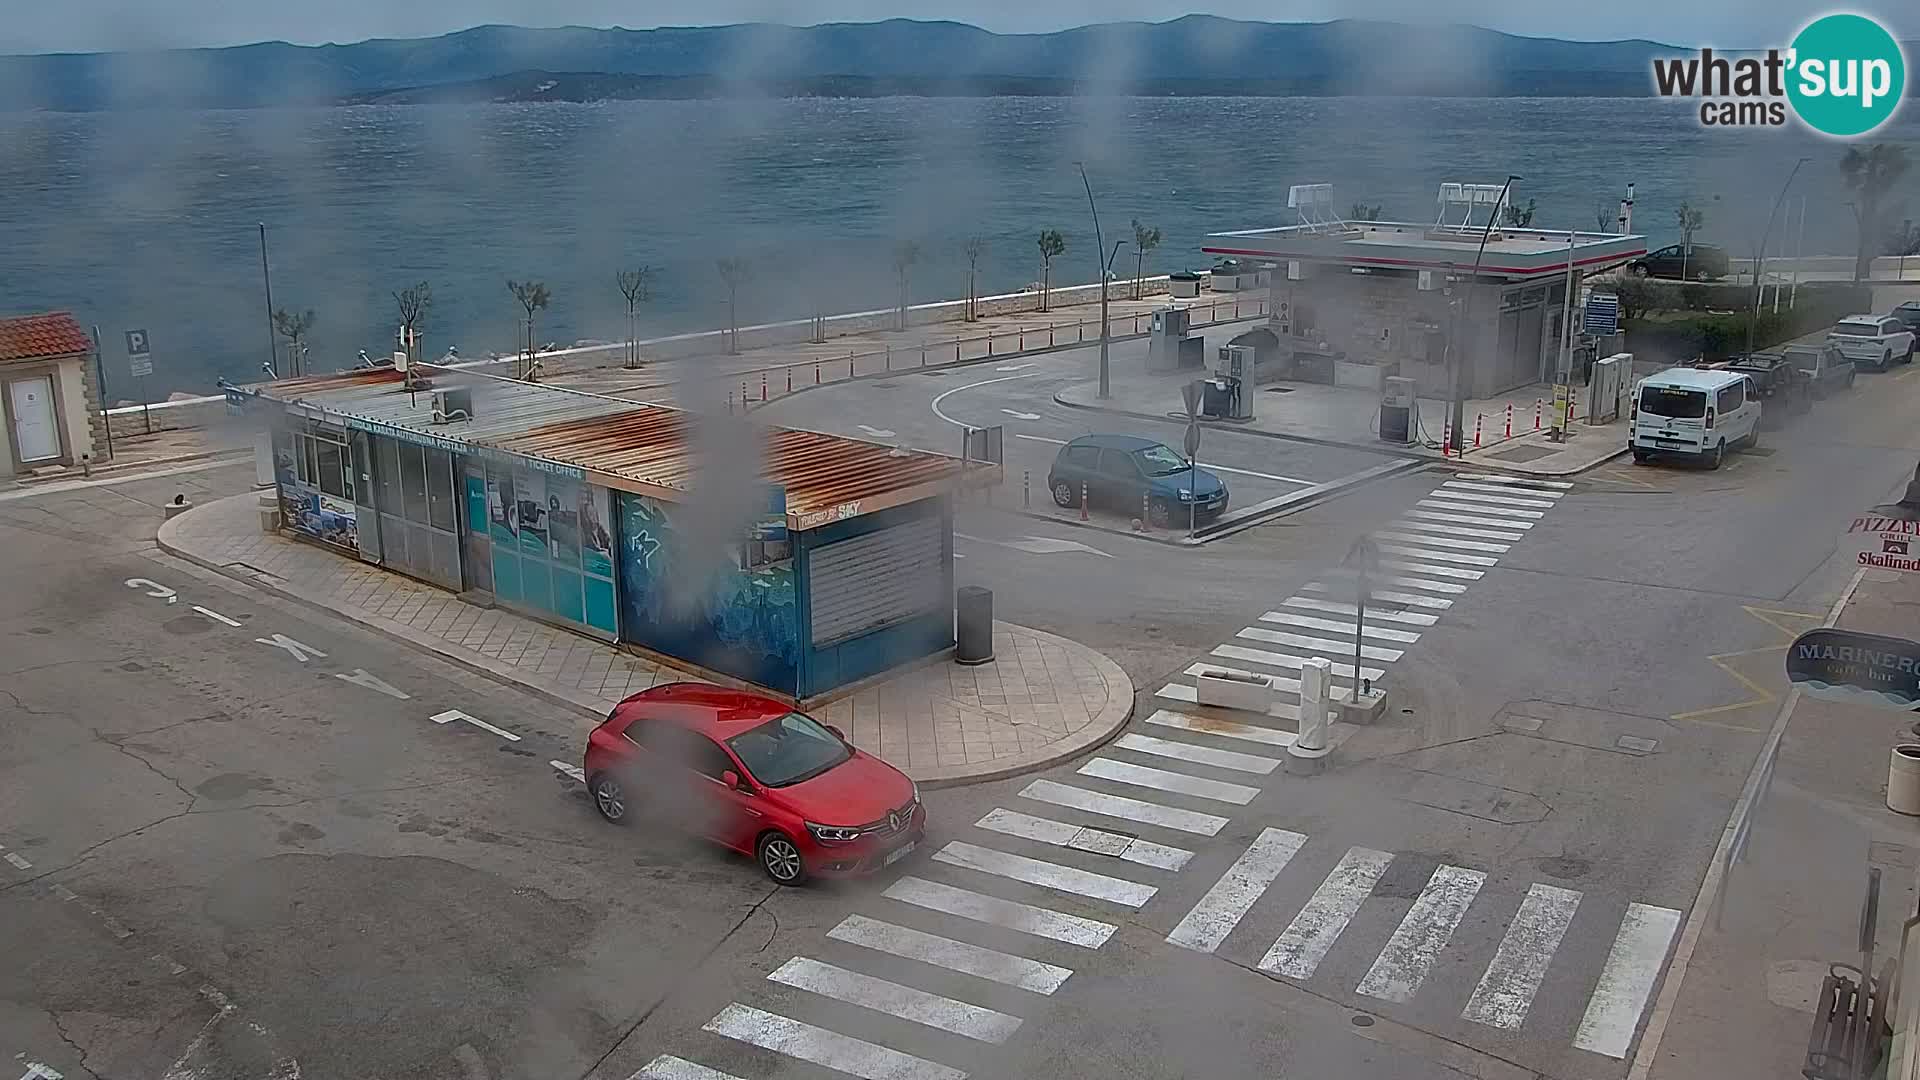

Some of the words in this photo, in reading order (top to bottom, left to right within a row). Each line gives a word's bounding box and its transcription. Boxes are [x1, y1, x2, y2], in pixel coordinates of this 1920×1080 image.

[130, 333, 143, 350] P
[528, 459, 555, 473] TICKET
[556, 465, 583, 479] OFFICE
[1868, 667, 1896, 682] bar
